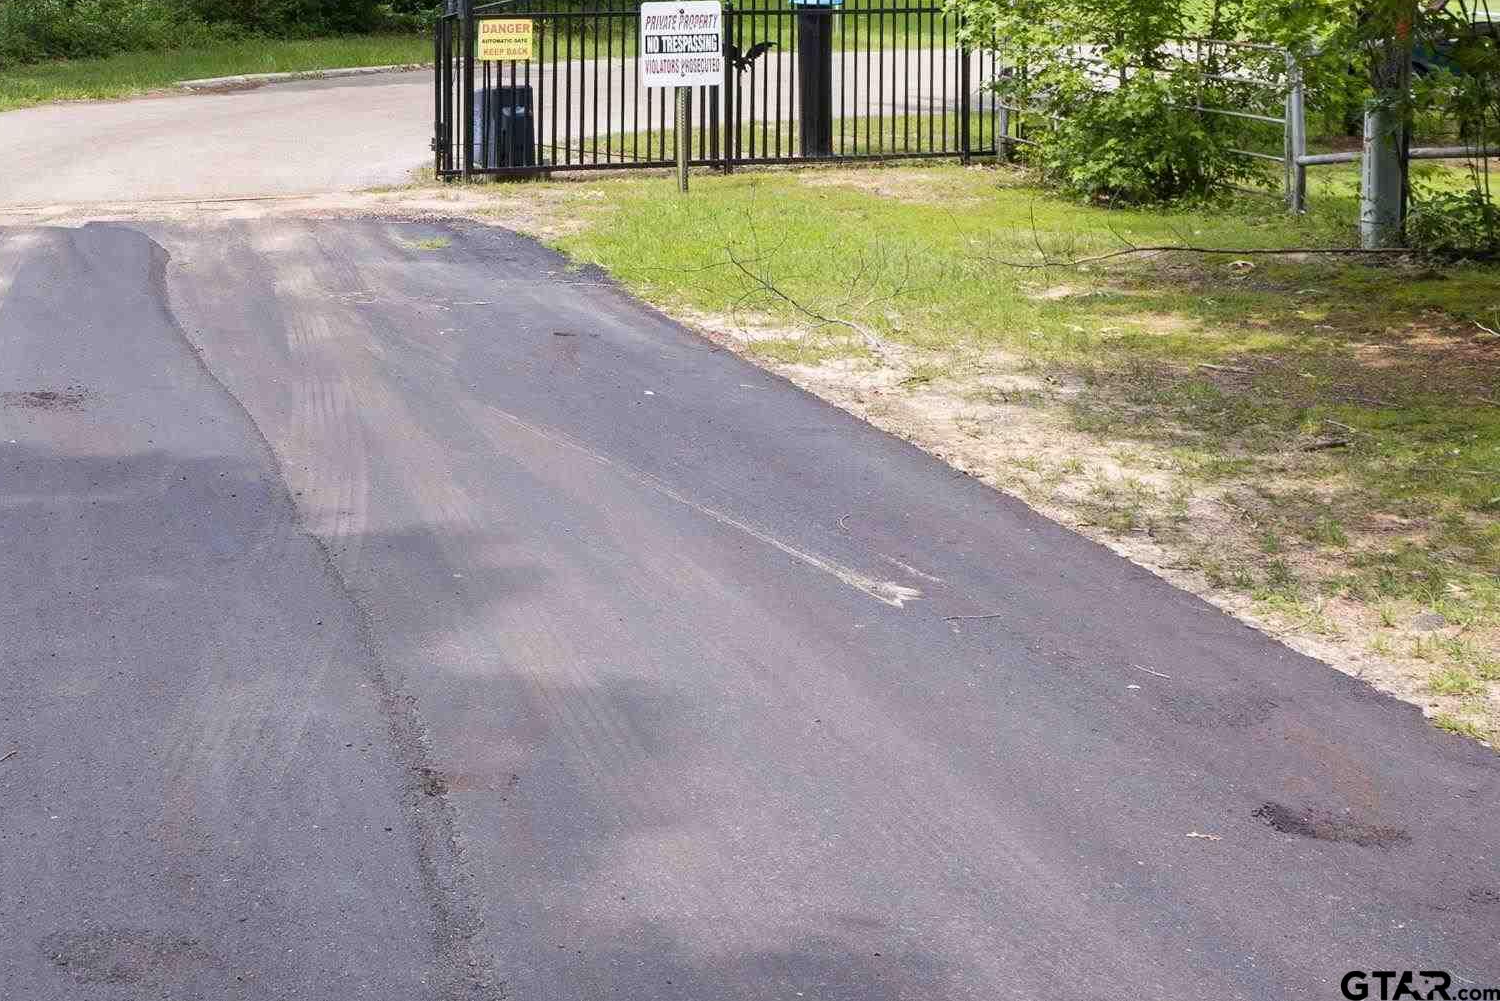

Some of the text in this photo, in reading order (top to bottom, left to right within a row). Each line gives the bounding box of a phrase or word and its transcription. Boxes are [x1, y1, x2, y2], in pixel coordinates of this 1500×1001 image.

[482, 23, 531, 34] DANGER
[645, 14, 718, 30] PRIVATE PROPERTY
[646, 34, 718, 53] NO TRESPASSING
[483, 48, 504, 56] KEEP
[645, 57, 720, 74] VIOLATORS PROSECUTED
